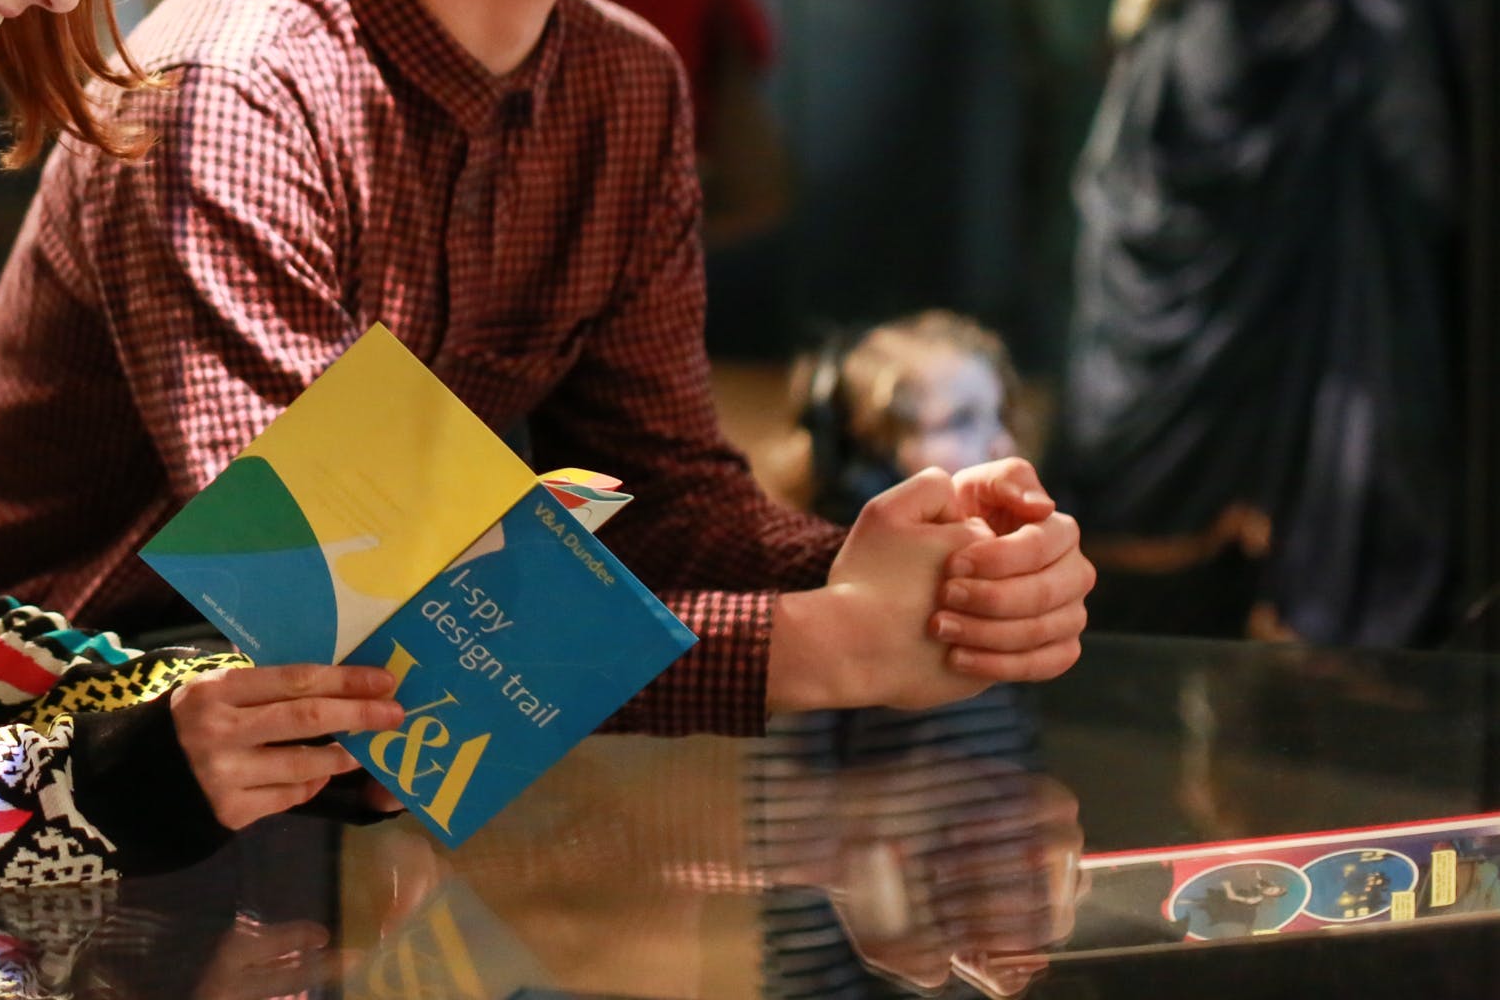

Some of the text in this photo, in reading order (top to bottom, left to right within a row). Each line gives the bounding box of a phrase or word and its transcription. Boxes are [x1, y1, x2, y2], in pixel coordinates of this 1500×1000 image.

[535, 501, 616, 587] V&A Dundee
[450, 568, 515, 633] I-spy
[421, 600, 561, 729] design trail
